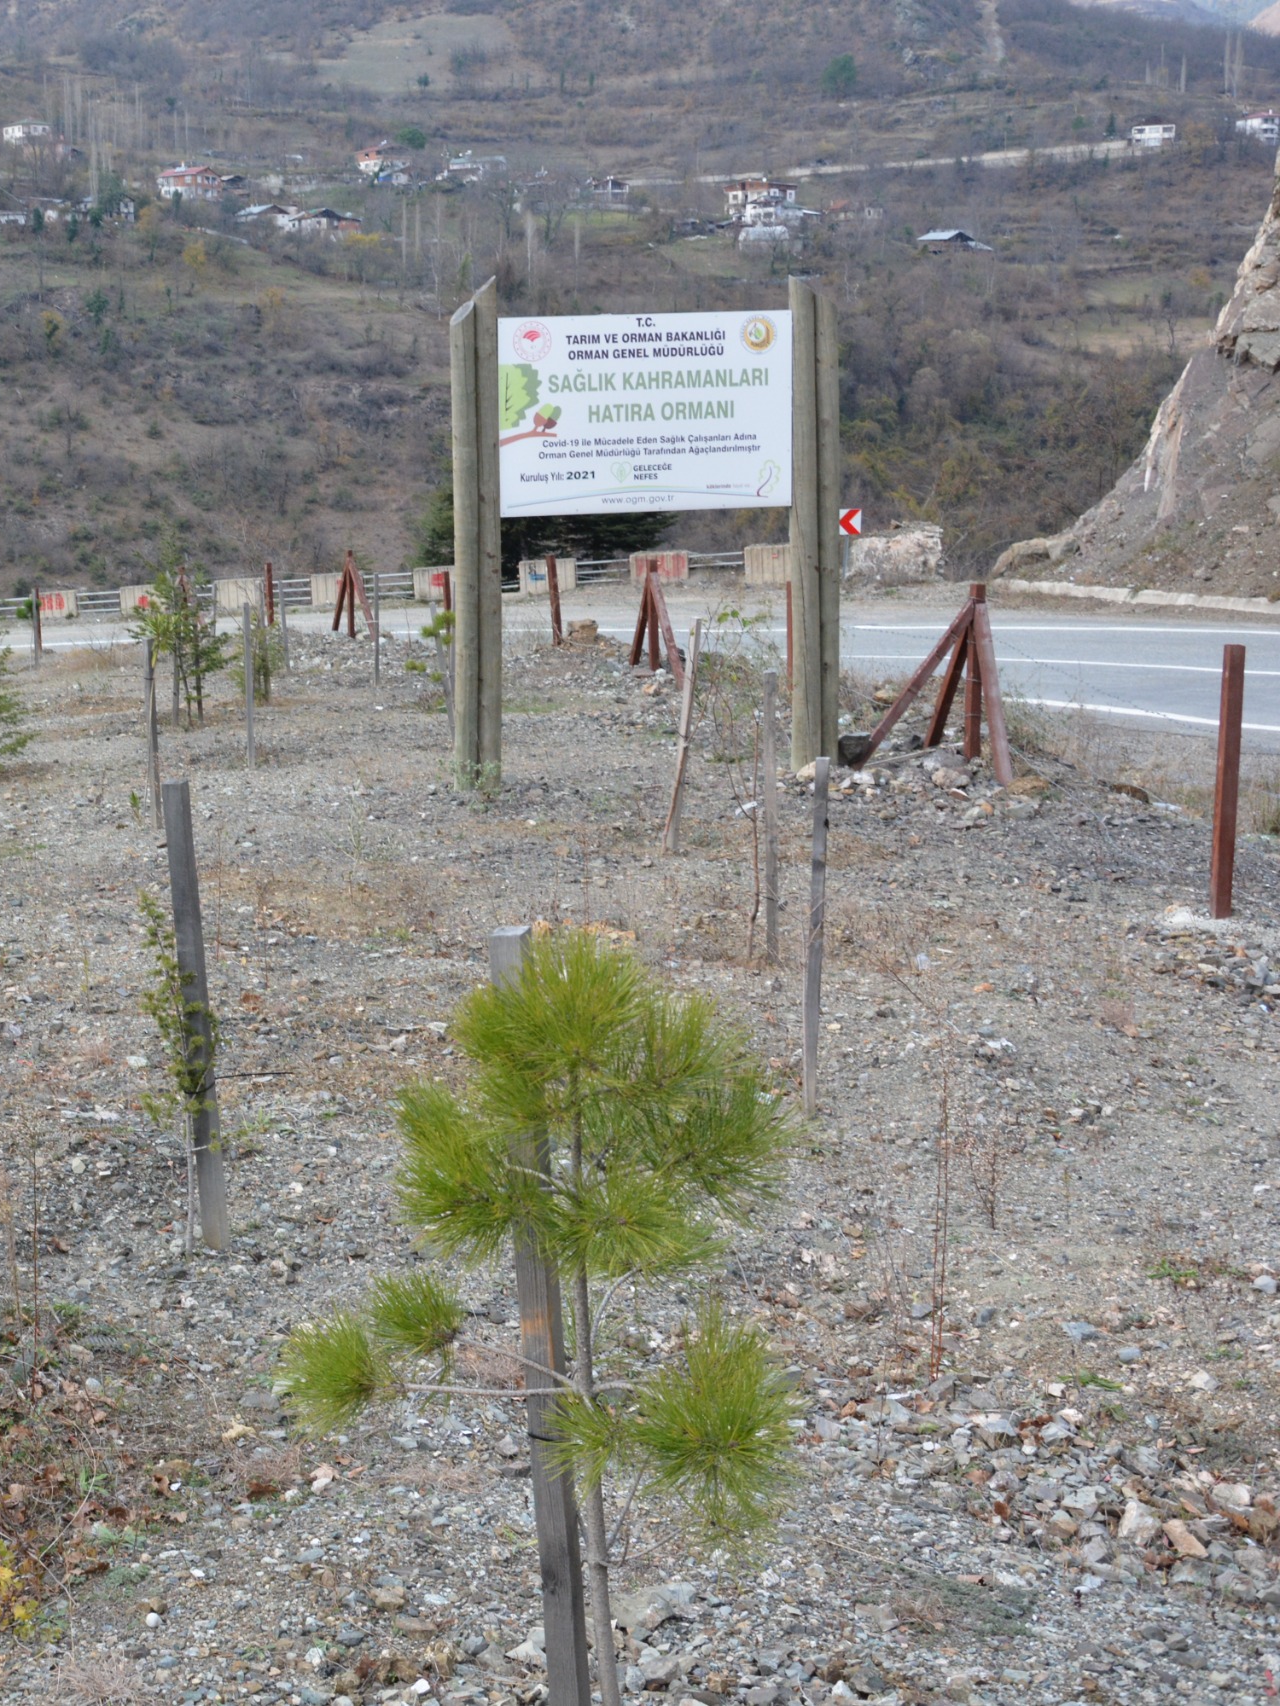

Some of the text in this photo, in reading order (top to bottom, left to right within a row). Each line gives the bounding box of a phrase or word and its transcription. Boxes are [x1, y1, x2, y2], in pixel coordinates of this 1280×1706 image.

[636, 317, 656, 328] T.C.
[566, 329, 726, 345] TARIM VE ORMAN BAKANLIĞI
[568, 343, 724, 361] ORMAN GENEL MÜDÜRLÜĞÜ
[548, 367, 768, 393] SAĞLIK KAHRAMANLARI
[589, 400, 734, 423] HATIRA ORMANI
[543, 432, 757, 448] Covid-19 ile Mücadele Eden Sağlık Çalışanları Adına
[539, 443, 760, 460] Orman Genel Müdürlüğü Tarafından Ağaçlandırılmıştır
[633, 463, 672, 472] GELECEĞE
[520, 472, 548, 484] Kuruluş
[566, 470, 595, 480] 2021
[601, 494, 674, 505] www.ogm.gov.tr
